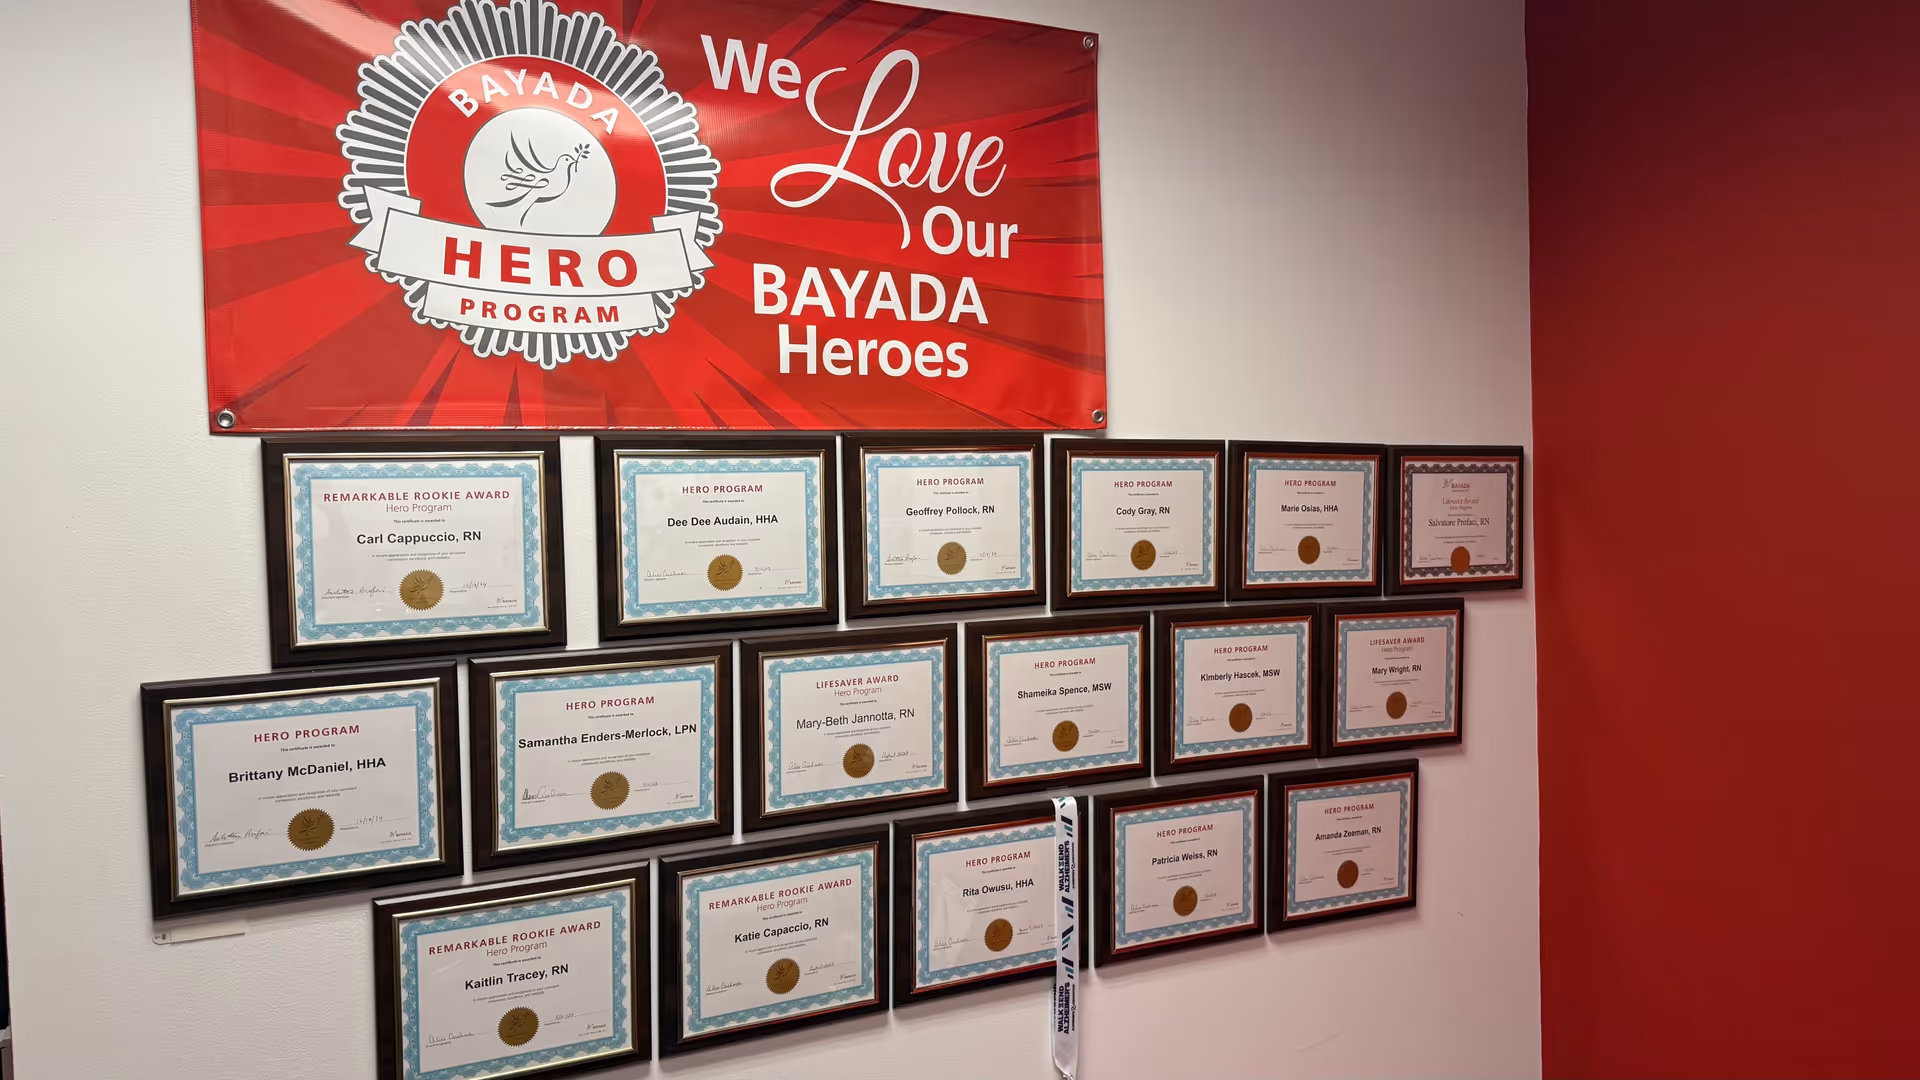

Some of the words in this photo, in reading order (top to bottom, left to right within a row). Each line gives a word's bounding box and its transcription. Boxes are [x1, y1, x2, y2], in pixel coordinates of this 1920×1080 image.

[701, 34, 801, 100] We
[448, 68, 623, 136] BAYADA
[771, 49, 1007, 249] Love
[923, 206, 1018, 259] Our
[444, 236, 639, 286] HERO
[754, 264, 989, 325] BAYADA
[460, 298, 620, 323] PROGRAM
[779, 325, 969, 378] Heroes
[683, 486, 709, 494] HERO
[714, 485, 763, 493] PROGRAM
[917, 478, 940, 486] HERO
[324, 492, 409, 502] REMARKABLE
[414, 492, 460, 500] ROOKIE
[466, 491, 510, 499] AWARD
[386, 504, 409, 513] Hero
[412, 503, 452, 513] Program
[906, 507, 943, 517] Geoffrey
[946, 506, 980, 515] Pollock,
[982, 505, 995, 513] RN
[1116, 507, 1136, 516] Cody
[1138, 507, 1157, 516] Gray,
[1159, 506, 1170, 514] RN
[1301, 505, 1322, 513] Osias,
[668, 517, 688, 527] Dee
[691, 516, 711, 526] Dee
[714, 516, 753, 525] Audain,
[756, 515, 778, 524] HHA
[1428, 519, 1455, 527] Salvatore
[357, 534, 383, 545] Carl
[387, 533, 459, 545] Cappuccio,
[463, 531, 481, 541] RN
[1235, 645, 1268, 653] PROGRAM
[1035, 661, 1055, 669] HERO
[1058, 658, 1096, 667] PROGRAM
[1372, 667, 1387, 675] Mary
[1389, 666, 1410, 674] Wright,
[816, 678, 863, 689] LIFESAVER
[866, 675, 899, 684] AWARD
[1201, 672, 1232, 682] Kimberly
[1234, 670, 1261, 679] Hascek,
[1263, 669, 1280, 677] MSW
[834, 689, 851, 697] Hero
[853, 687, 882, 697] Program
[1018, 688, 1057, 699] Shameika
[1059, 685, 1090, 695] Spence,
[1092, 683, 1111, 691] MSW
[566, 701, 596, 711] HERO
[600, 696, 655, 708] PROGRAM
[796, 715, 849, 730] Mary-Beth
[852, 711, 896, 724] Jannotta,
[900, 708, 915, 718] RN
[254, 731, 290, 743] HERO
[295, 724, 360, 739] PROGRAM
[519, 735, 578, 749] Samantha
[581, 727, 672, 743] Enders-Merlock,
[675, 724, 697, 735] LPN
[229, 768, 283, 783] Brittany
[288, 761, 353, 777] McDaniel,
[357, 757, 386, 769] HHA
[1344, 804, 1374, 812] PROGRAM
[1157, 829, 1176, 838] HERO
[1179, 824, 1213, 834] PROGRAM
[1315, 831, 1342, 841] Amanda
[1343, 829, 1370, 838] Zeeman,
[1372, 826, 1381, 834] RN
[966, 858, 988, 867] HERO
[991, 851, 1031, 863] PROGRAM
[1152, 855, 1179, 865] Patricia
[1182, 852, 1205, 861] Weiss,
[1207, 849, 1218, 857] RN
[709, 892, 775, 910] REMARKABLE
[778, 885, 814, 898] ROOKIE
[818, 879, 852, 891] AWARD
[962, 886, 979, 897] Rita
[982, 884, 1013, 894] Owusu,
[1016, 878, 1034, 888] HHA
[756, 903, 775, 913] Hero
[777, 897, 808, 909] Program
[429, 936, 508, 955] REMARKABLE
[512, 928, 555, 942] ROOKIE
[560, 921, 601, 935] AWARD
[735, 931, 761, 944] Katie
[763, 923, 812, 937] Capaccio,
[815, 918, 829, 928] RN
[486, 947, 508, 957] Hero
[511, 941, 548, 955] Program
[465, 976, 503, 990] Kaitlin
[507, 968, 548, 984] Tracey,
[552, 964, 569, 975] RN
